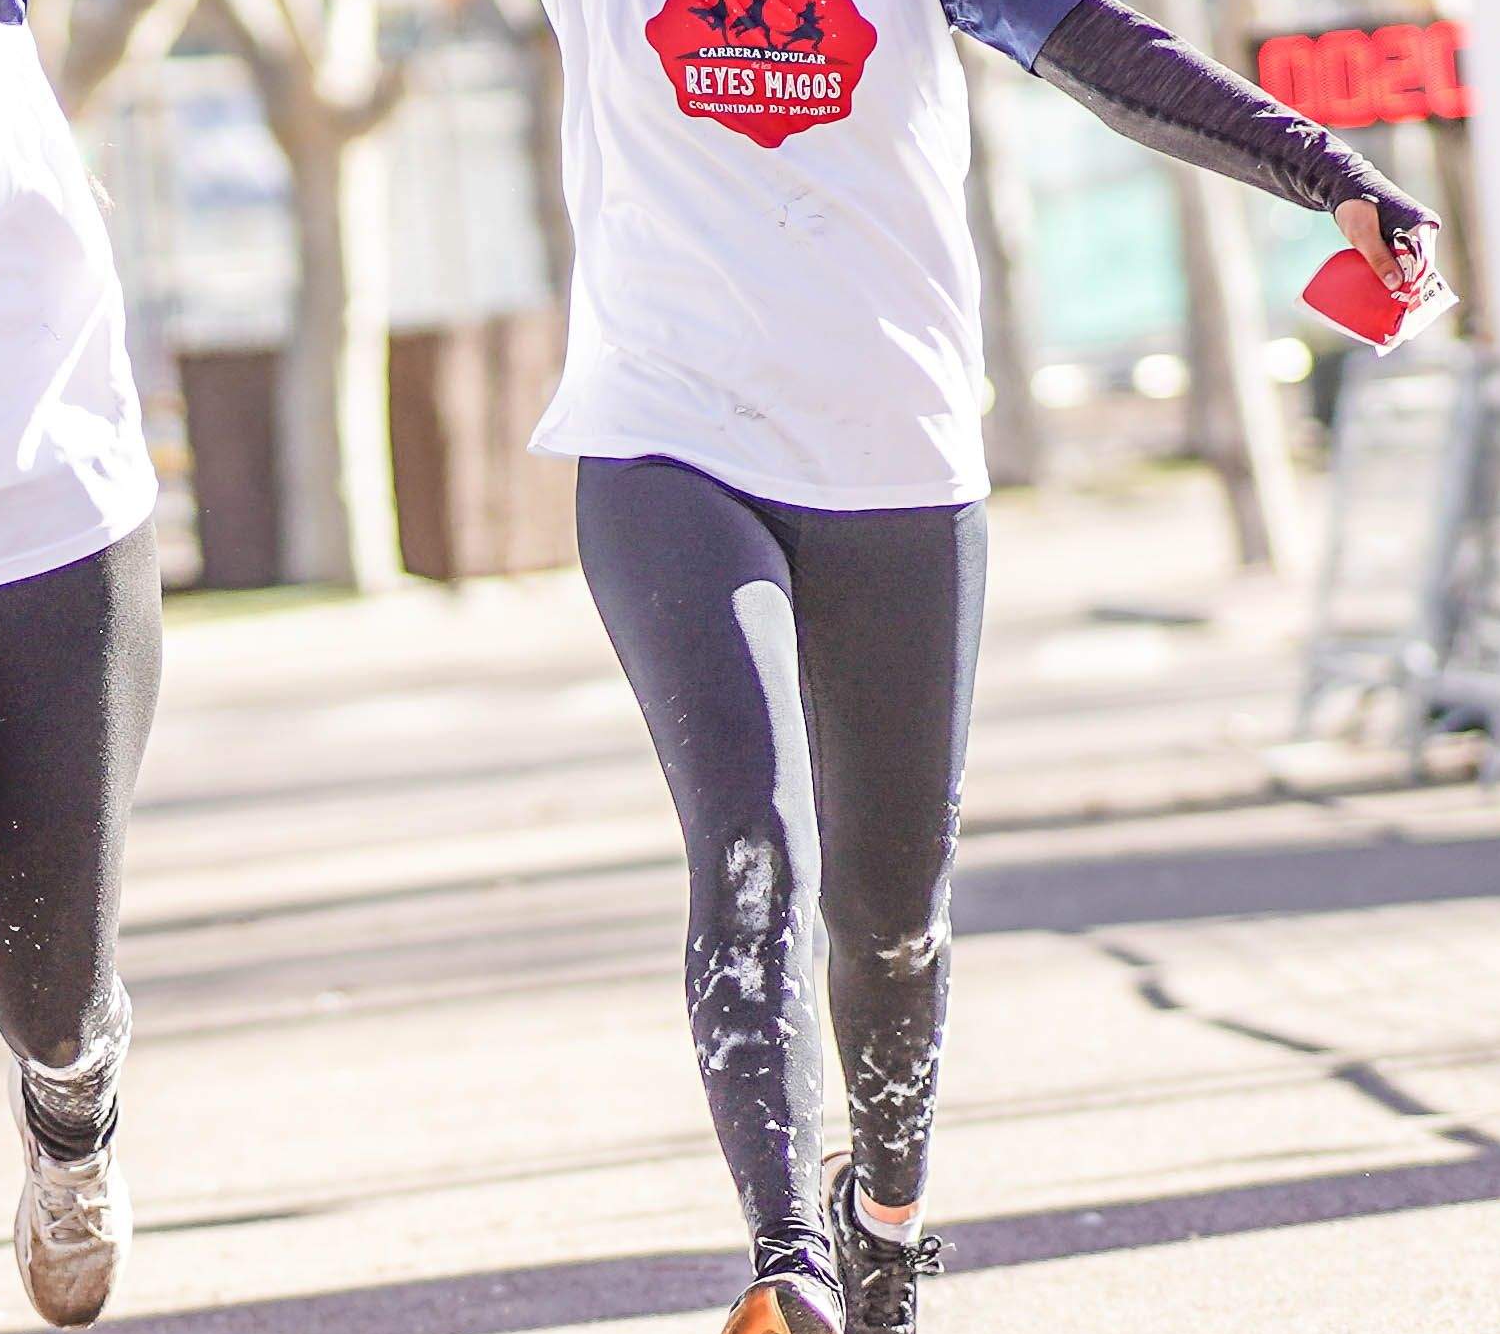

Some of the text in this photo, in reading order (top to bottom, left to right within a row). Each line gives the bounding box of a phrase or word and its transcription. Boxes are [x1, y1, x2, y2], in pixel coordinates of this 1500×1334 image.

[699, 47, 826, 65] CARRERA POPULAR
[685, 65, 842, 100] REYES MAGOS
[688, 100, 841, 116] COMUNIDAD DE MADRID
